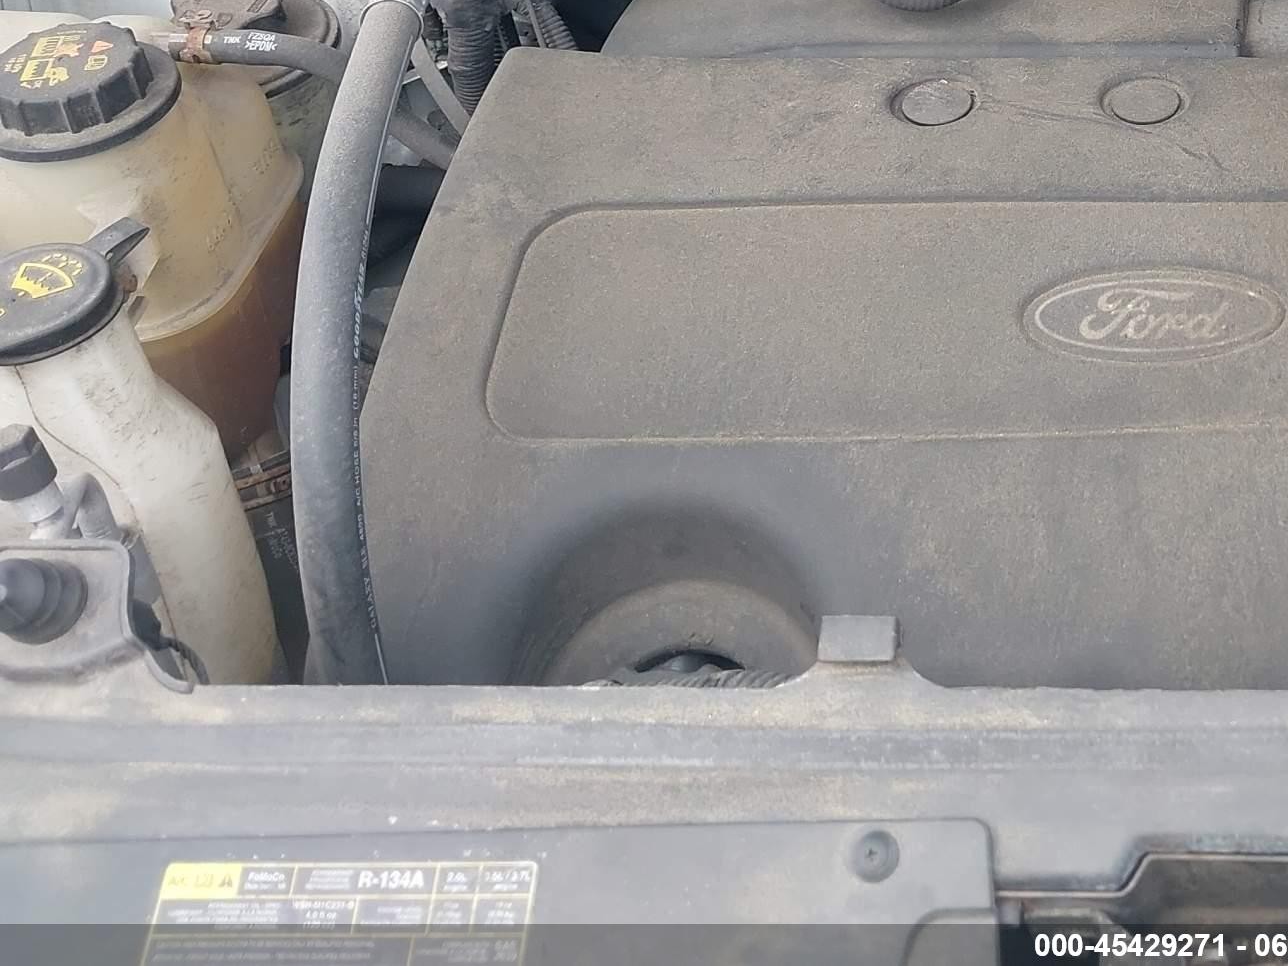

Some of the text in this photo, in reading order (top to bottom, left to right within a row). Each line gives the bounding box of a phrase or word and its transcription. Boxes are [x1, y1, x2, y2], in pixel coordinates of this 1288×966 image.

[353, 262, 365, 359] GOODYEAR
[1078, 287, 1230, 341] Ford
[357, 870, 425, 889] R-134A
